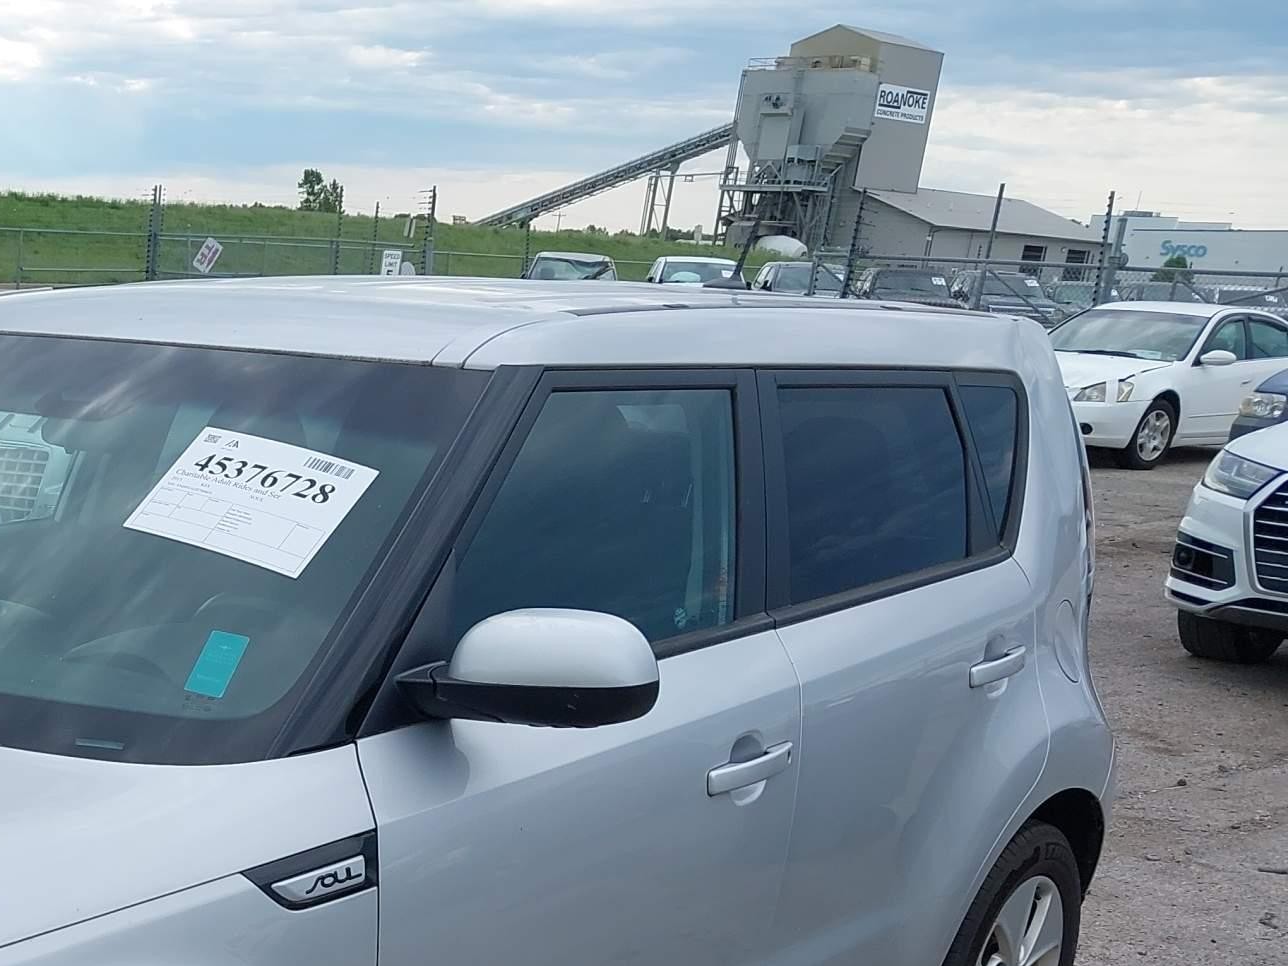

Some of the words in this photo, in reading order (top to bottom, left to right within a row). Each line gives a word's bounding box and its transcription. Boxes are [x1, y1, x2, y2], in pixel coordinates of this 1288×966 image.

[879, 90, 927, 109] ROANOKE
[1159, 239, 1208, 258] Sysco
[194, 453, 336, 504] 45376728
[213, 476, 232, 487] Adult
[232, 481, 252, 492] Rides
[253, 488, 268, 496] and
